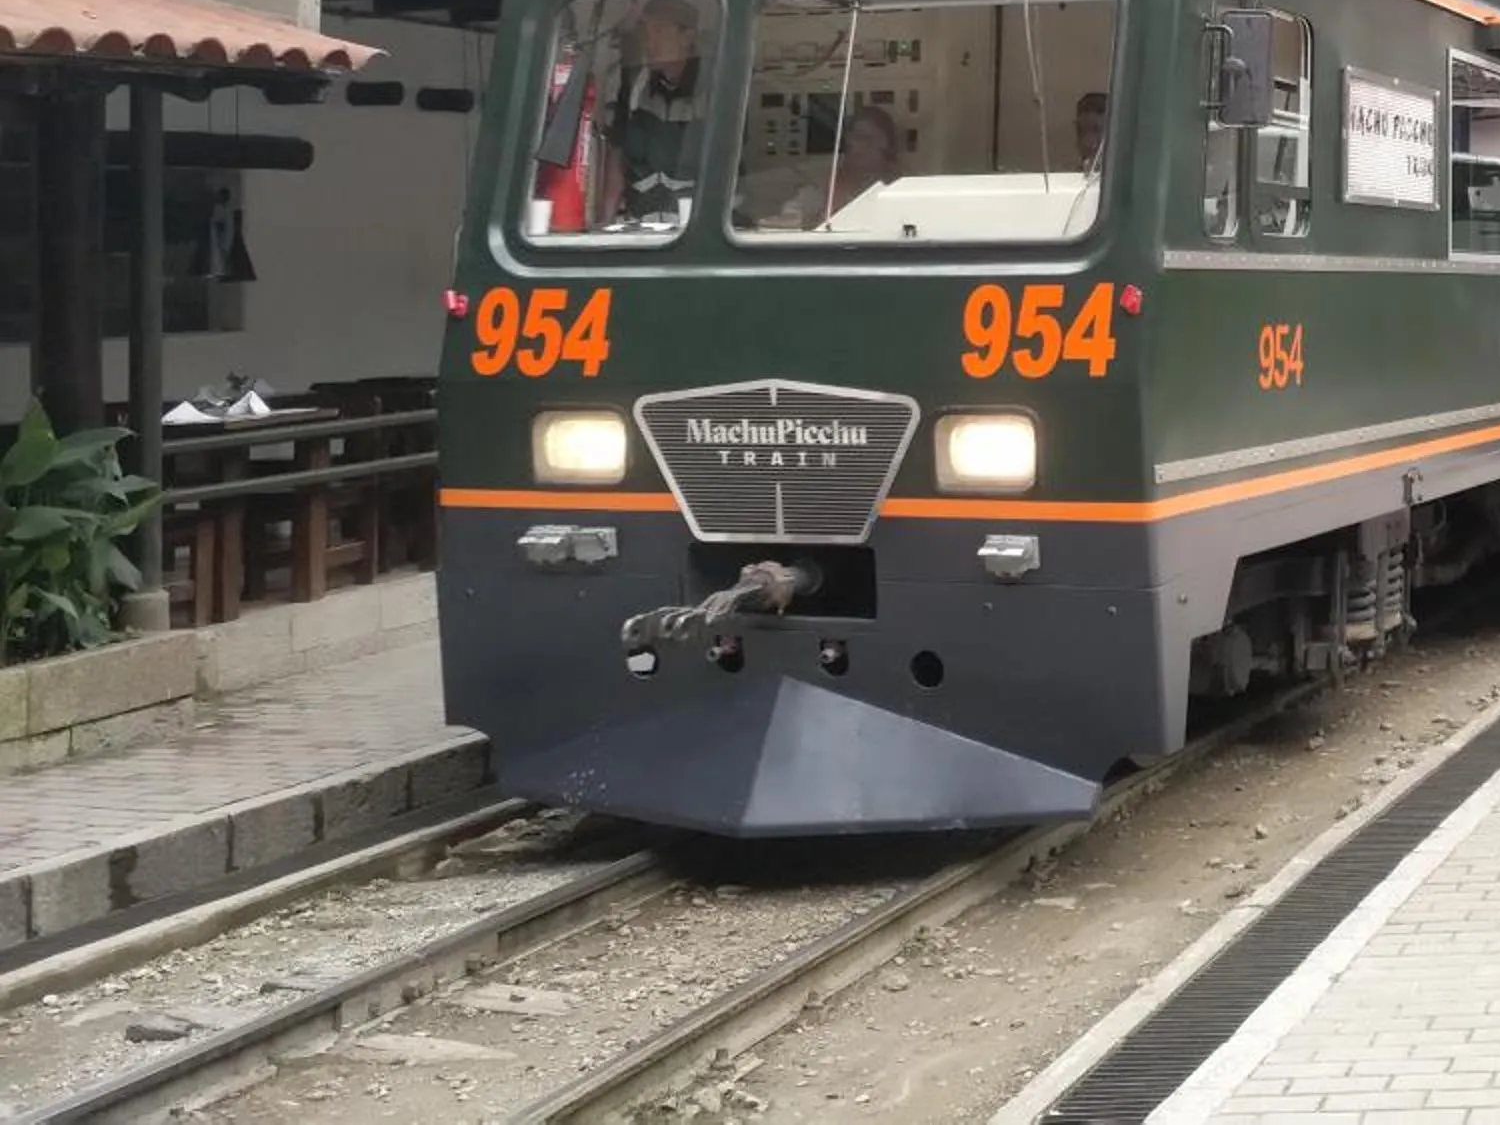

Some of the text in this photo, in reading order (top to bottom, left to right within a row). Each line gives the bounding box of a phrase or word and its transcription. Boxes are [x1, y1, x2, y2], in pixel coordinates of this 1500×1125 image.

[471, 287, 613, 378] 954
[960, 282, 1117, 379] 954
[1258, 322, 1304, 390] 954
[685, 418, 868, 445] MachuPicchu
[719, 450, 837, 467] TRAIN
